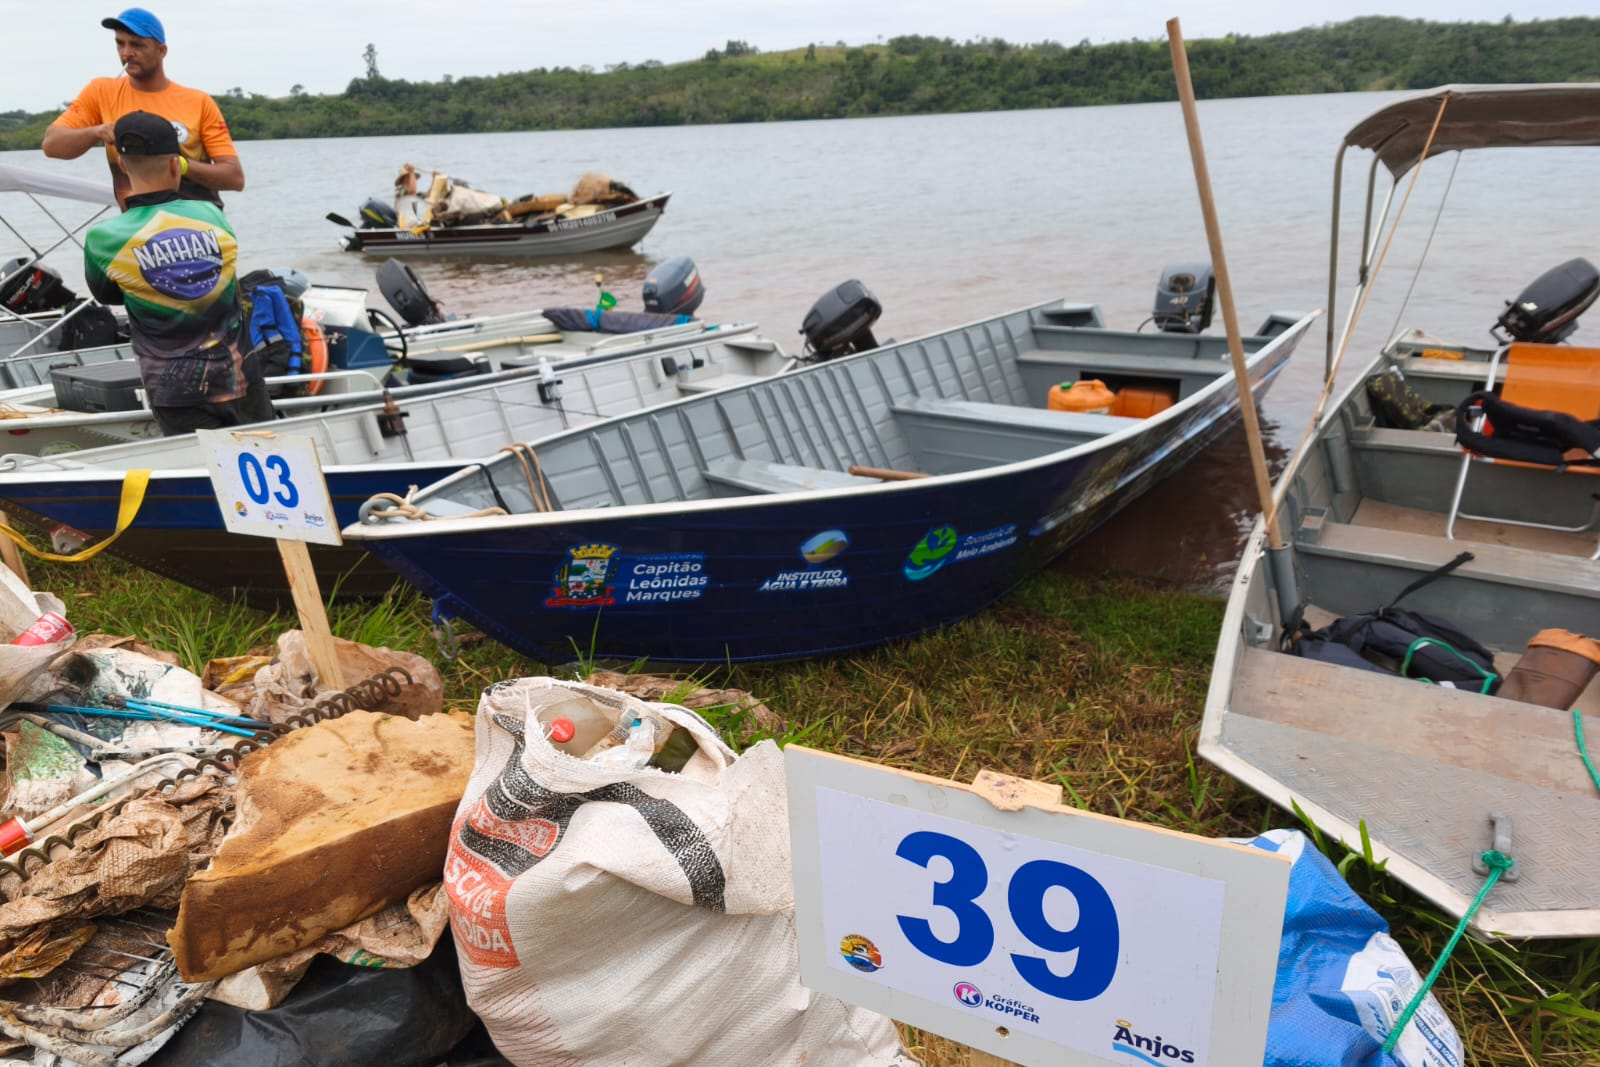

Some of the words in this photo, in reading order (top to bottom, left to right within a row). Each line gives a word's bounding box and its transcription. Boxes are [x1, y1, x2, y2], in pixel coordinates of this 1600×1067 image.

[132, 229, 220, 271] NATHAN
[238, 452, 299, 508] 03
[633, 561, 702, 576] Capitão
[777, 569, 843, 581] INSTITUTO
[629, 575, 708, 590] Leônidas
[760, 579, 797, 591] ÁGUA
[799, 580, 809, 590] E
[811, 577, 848, 588] TERRA
[626, 589, 701, 603] Marques
[896, 831, 1120, 1002] 39
[985, 1000, 1040, 1024] KOPPER
[992, 994, 1034, 1013] Gráfica
[1113, 1024, 1195, 1064] Anjos
